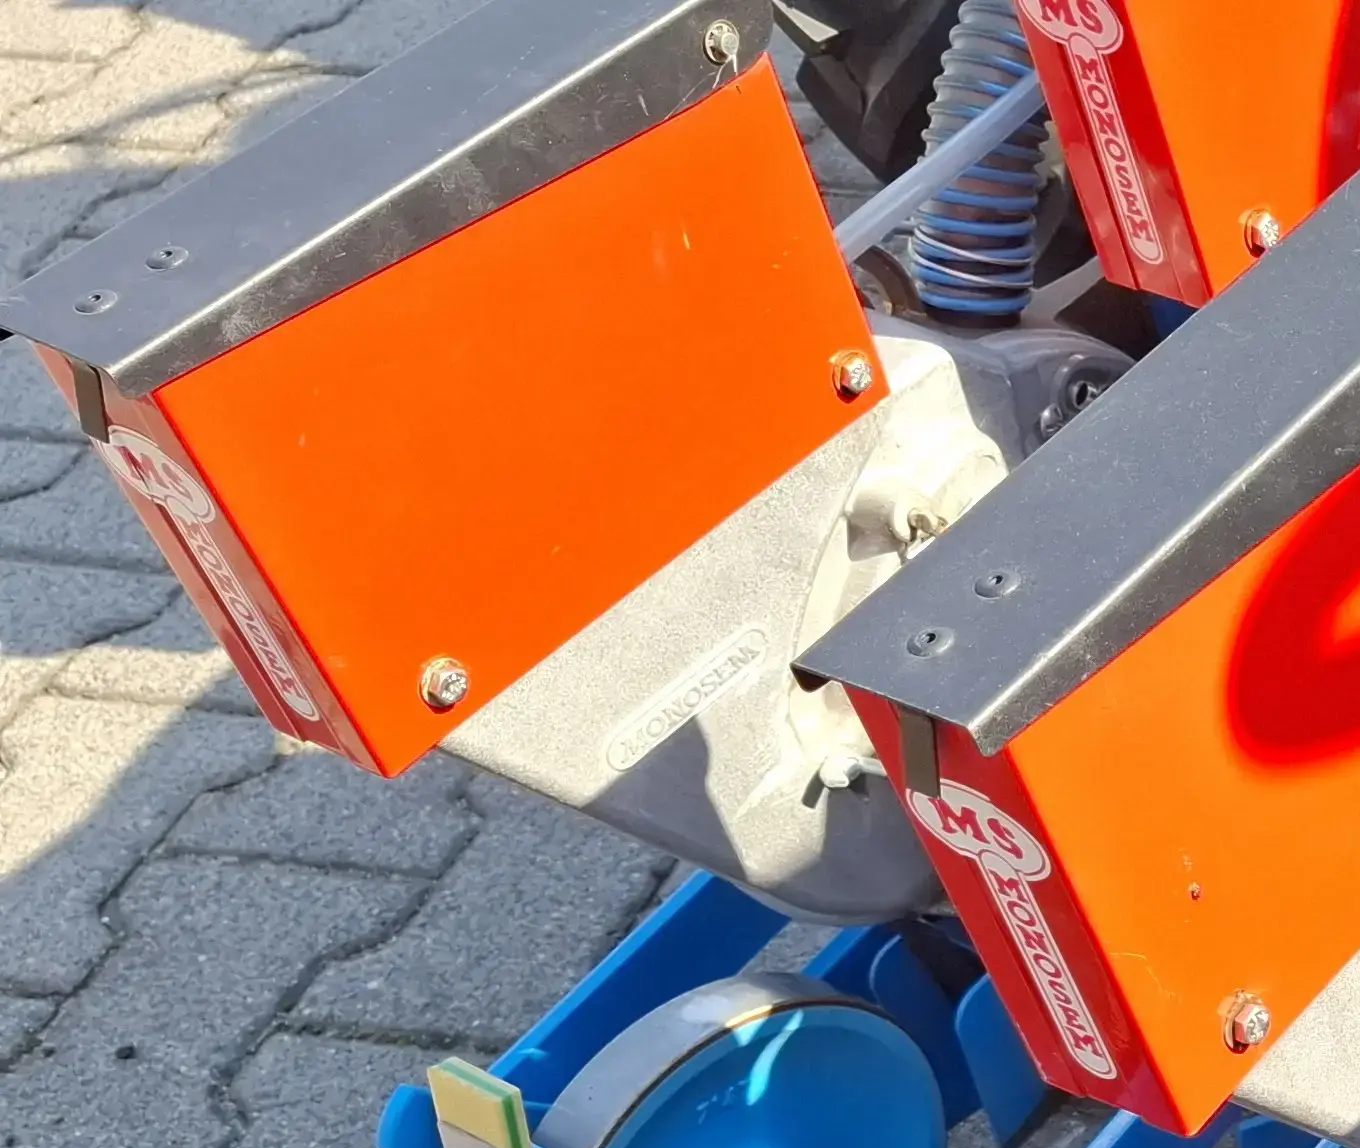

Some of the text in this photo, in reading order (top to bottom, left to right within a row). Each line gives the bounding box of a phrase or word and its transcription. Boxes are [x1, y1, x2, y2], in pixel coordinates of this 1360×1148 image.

[1039, 0, 1103, 33] MS
[1075, 55, 1154, 243] MONOSEM
[113, 446, 191, 499] MS
[928, 797, 1023, 859] MS
[989, 869, 1104, 1058] MONOSEM
